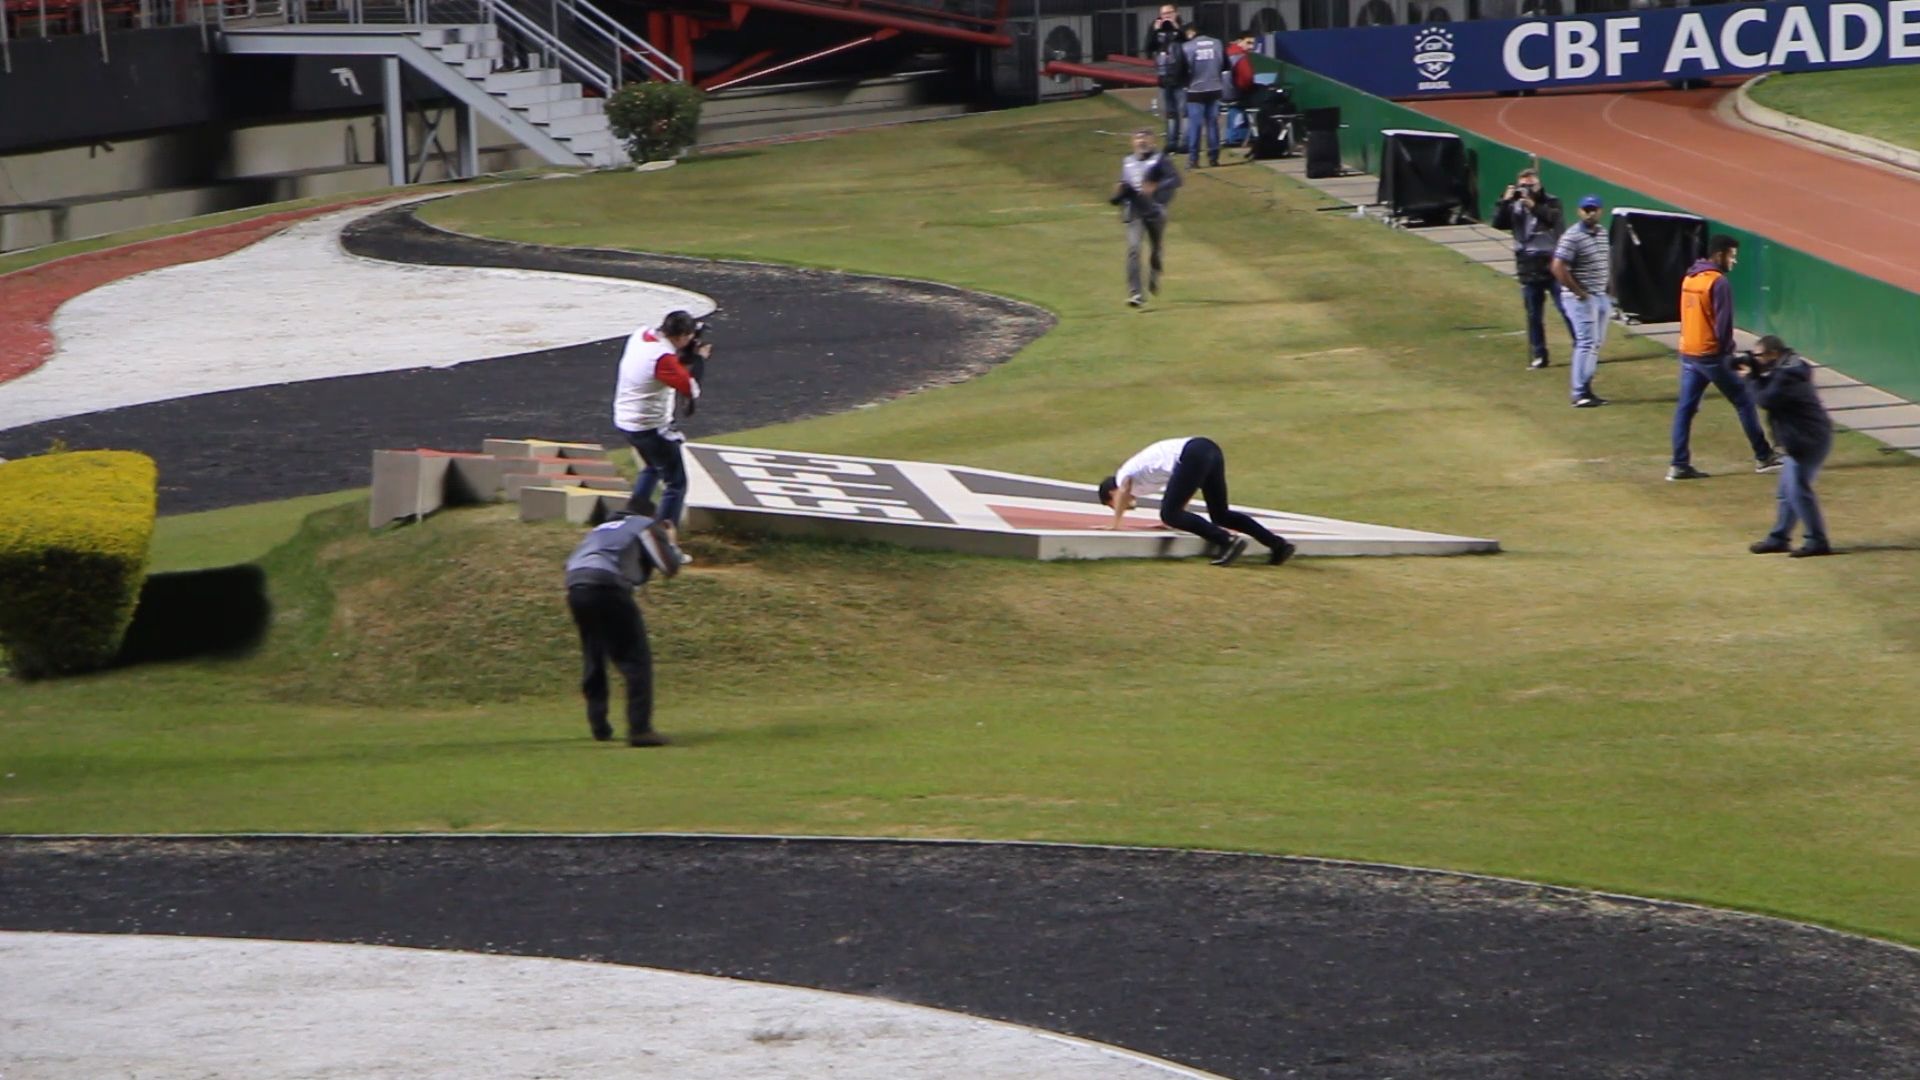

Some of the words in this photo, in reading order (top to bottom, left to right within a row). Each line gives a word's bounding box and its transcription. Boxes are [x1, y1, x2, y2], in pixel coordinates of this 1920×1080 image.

[1502, 17, 1641, 82] CBF
[1663, 0, 1920, 73] ACADE
[717, 452, 924, 520] SPFC
